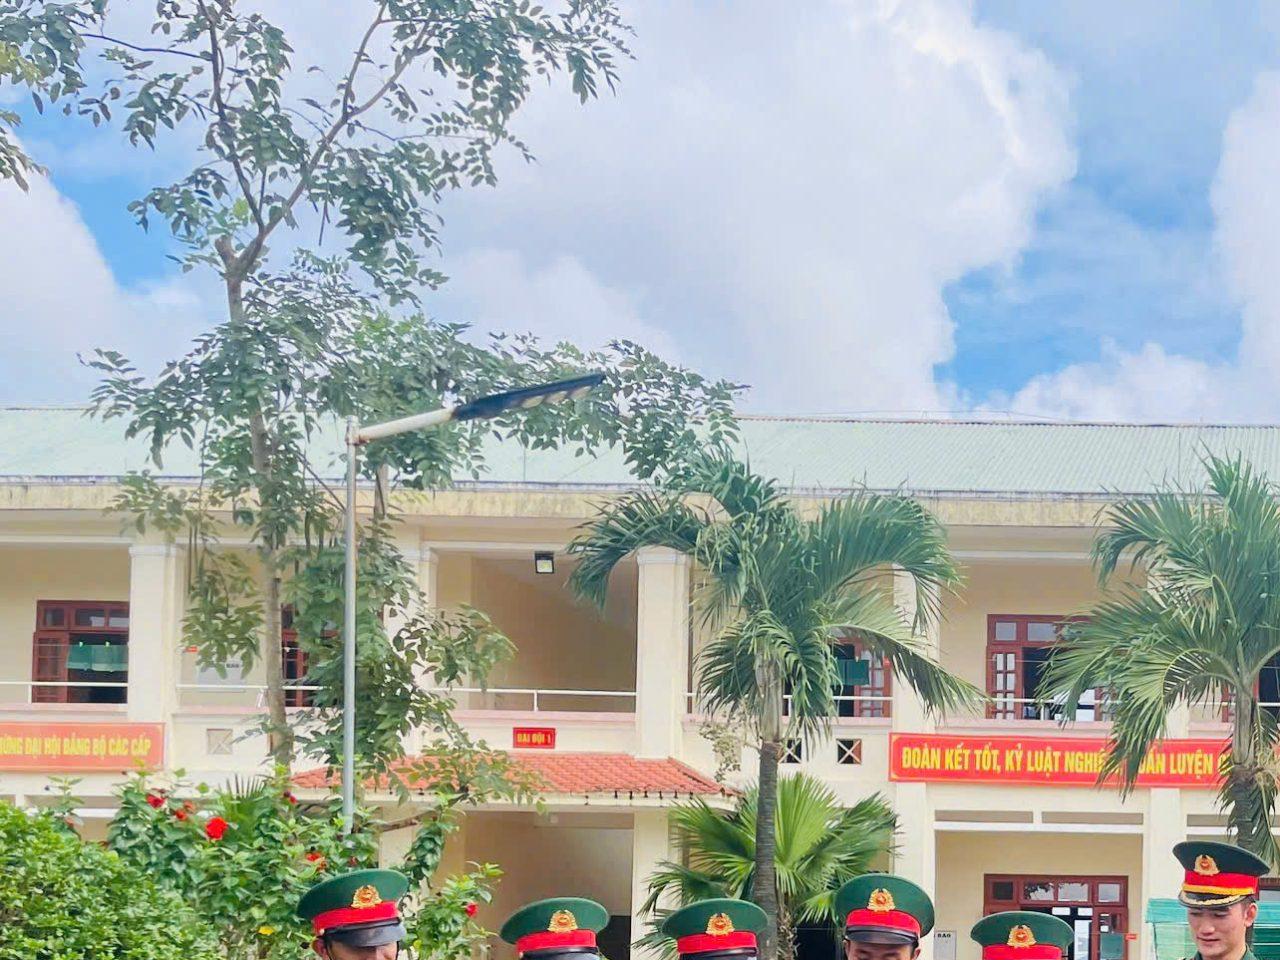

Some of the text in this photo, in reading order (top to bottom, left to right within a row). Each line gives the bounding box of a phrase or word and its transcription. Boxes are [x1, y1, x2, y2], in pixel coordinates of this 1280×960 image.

[902, 742, 941, 770] ĐOÀN
[944, 742, 971, 771] KẾT
[974, 742, 1001, 774] TỐT,
[1005, 743, 1024, 772] KỶ
[1027, 746, 1061, 778] LUẬT
[1064, 748, 1121, 774] NGHIÊ
[1134, 744, 1166, 775] UẤN
[1170, 749, 1213, 780] LUYỆN
